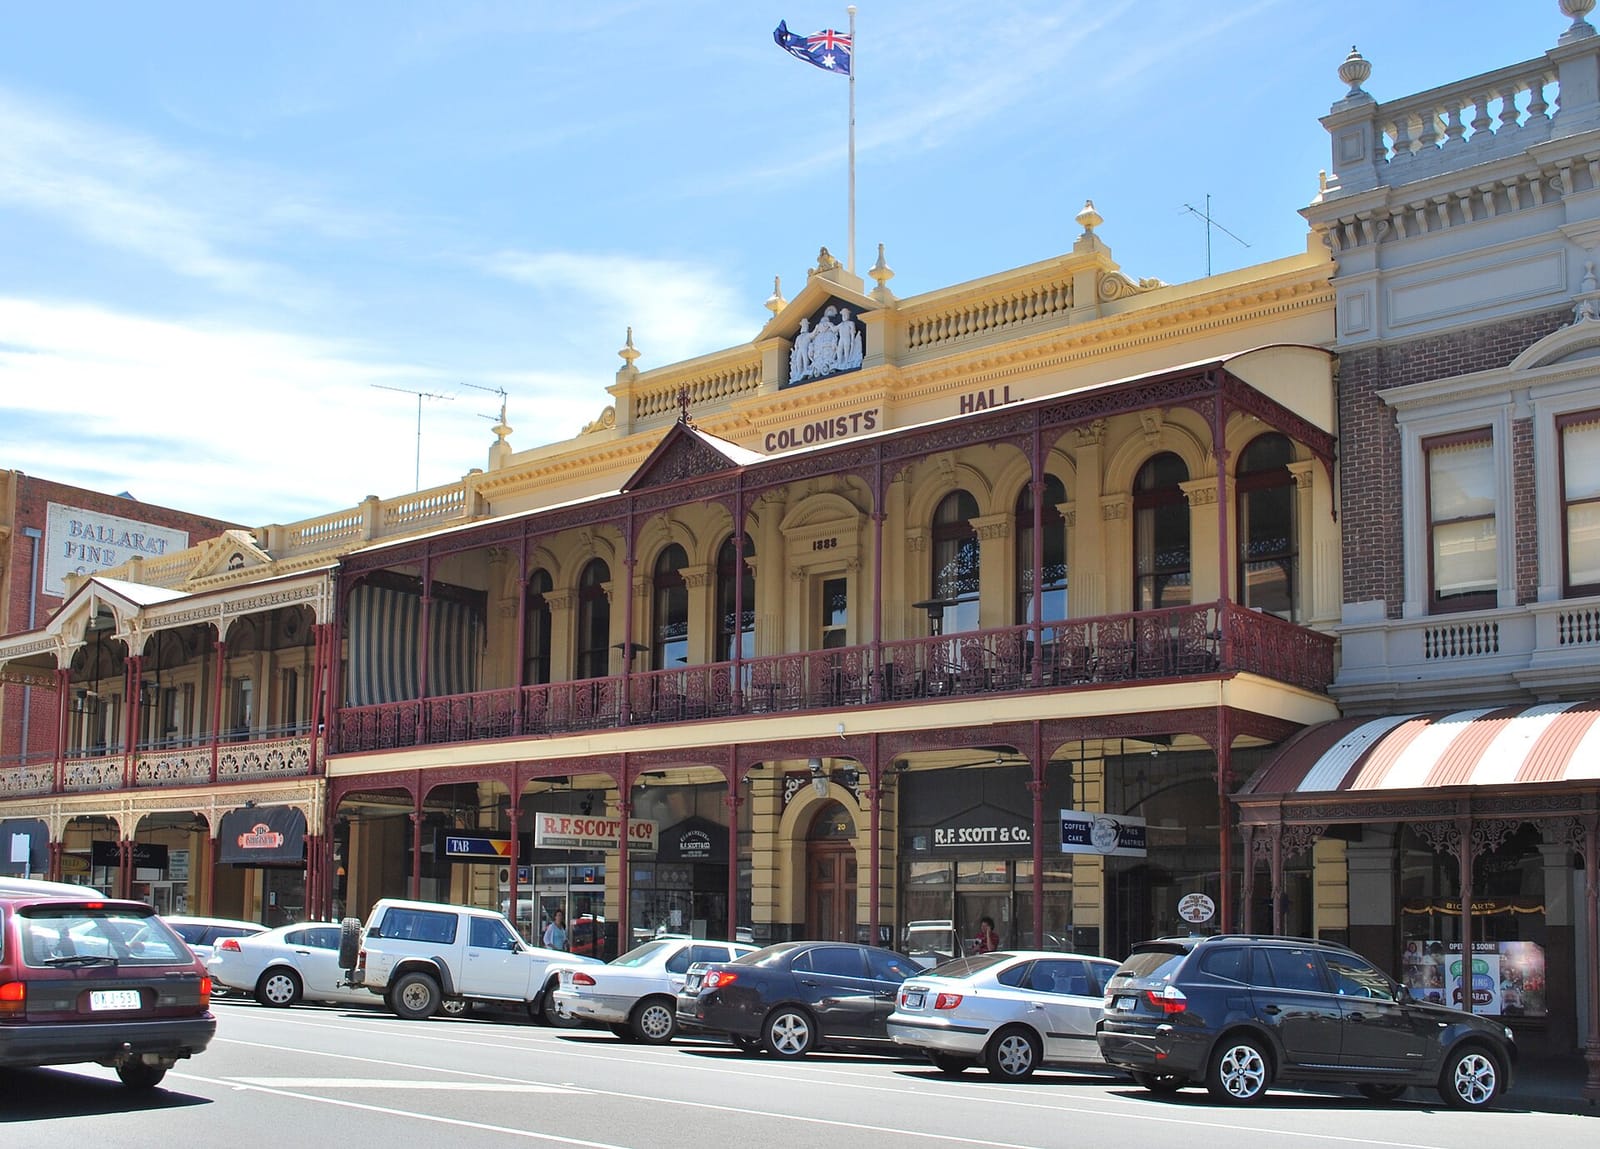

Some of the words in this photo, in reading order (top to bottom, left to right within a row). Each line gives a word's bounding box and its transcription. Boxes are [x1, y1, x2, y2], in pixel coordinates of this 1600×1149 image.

[765, 408, 879, 452] COLONISTS'
[68, 520, 168, 556] BALLARAT
[812, 537, 838, 551] 1888
[63, 540, 116, 567] FINE
[1063, 822, 1086, 831] COFFEE
[935, 828, 955, 844] R.F.
[958, 827, 998, 843] SCOTT
[999, 827, 1010, 842] &
[1011, 826, 1031, 841] Co.
[1067, 834, 1084, 843] CAKE
[451, 839, 470, 853] TAB
[1476, 943, 1496, 951] SOON!
